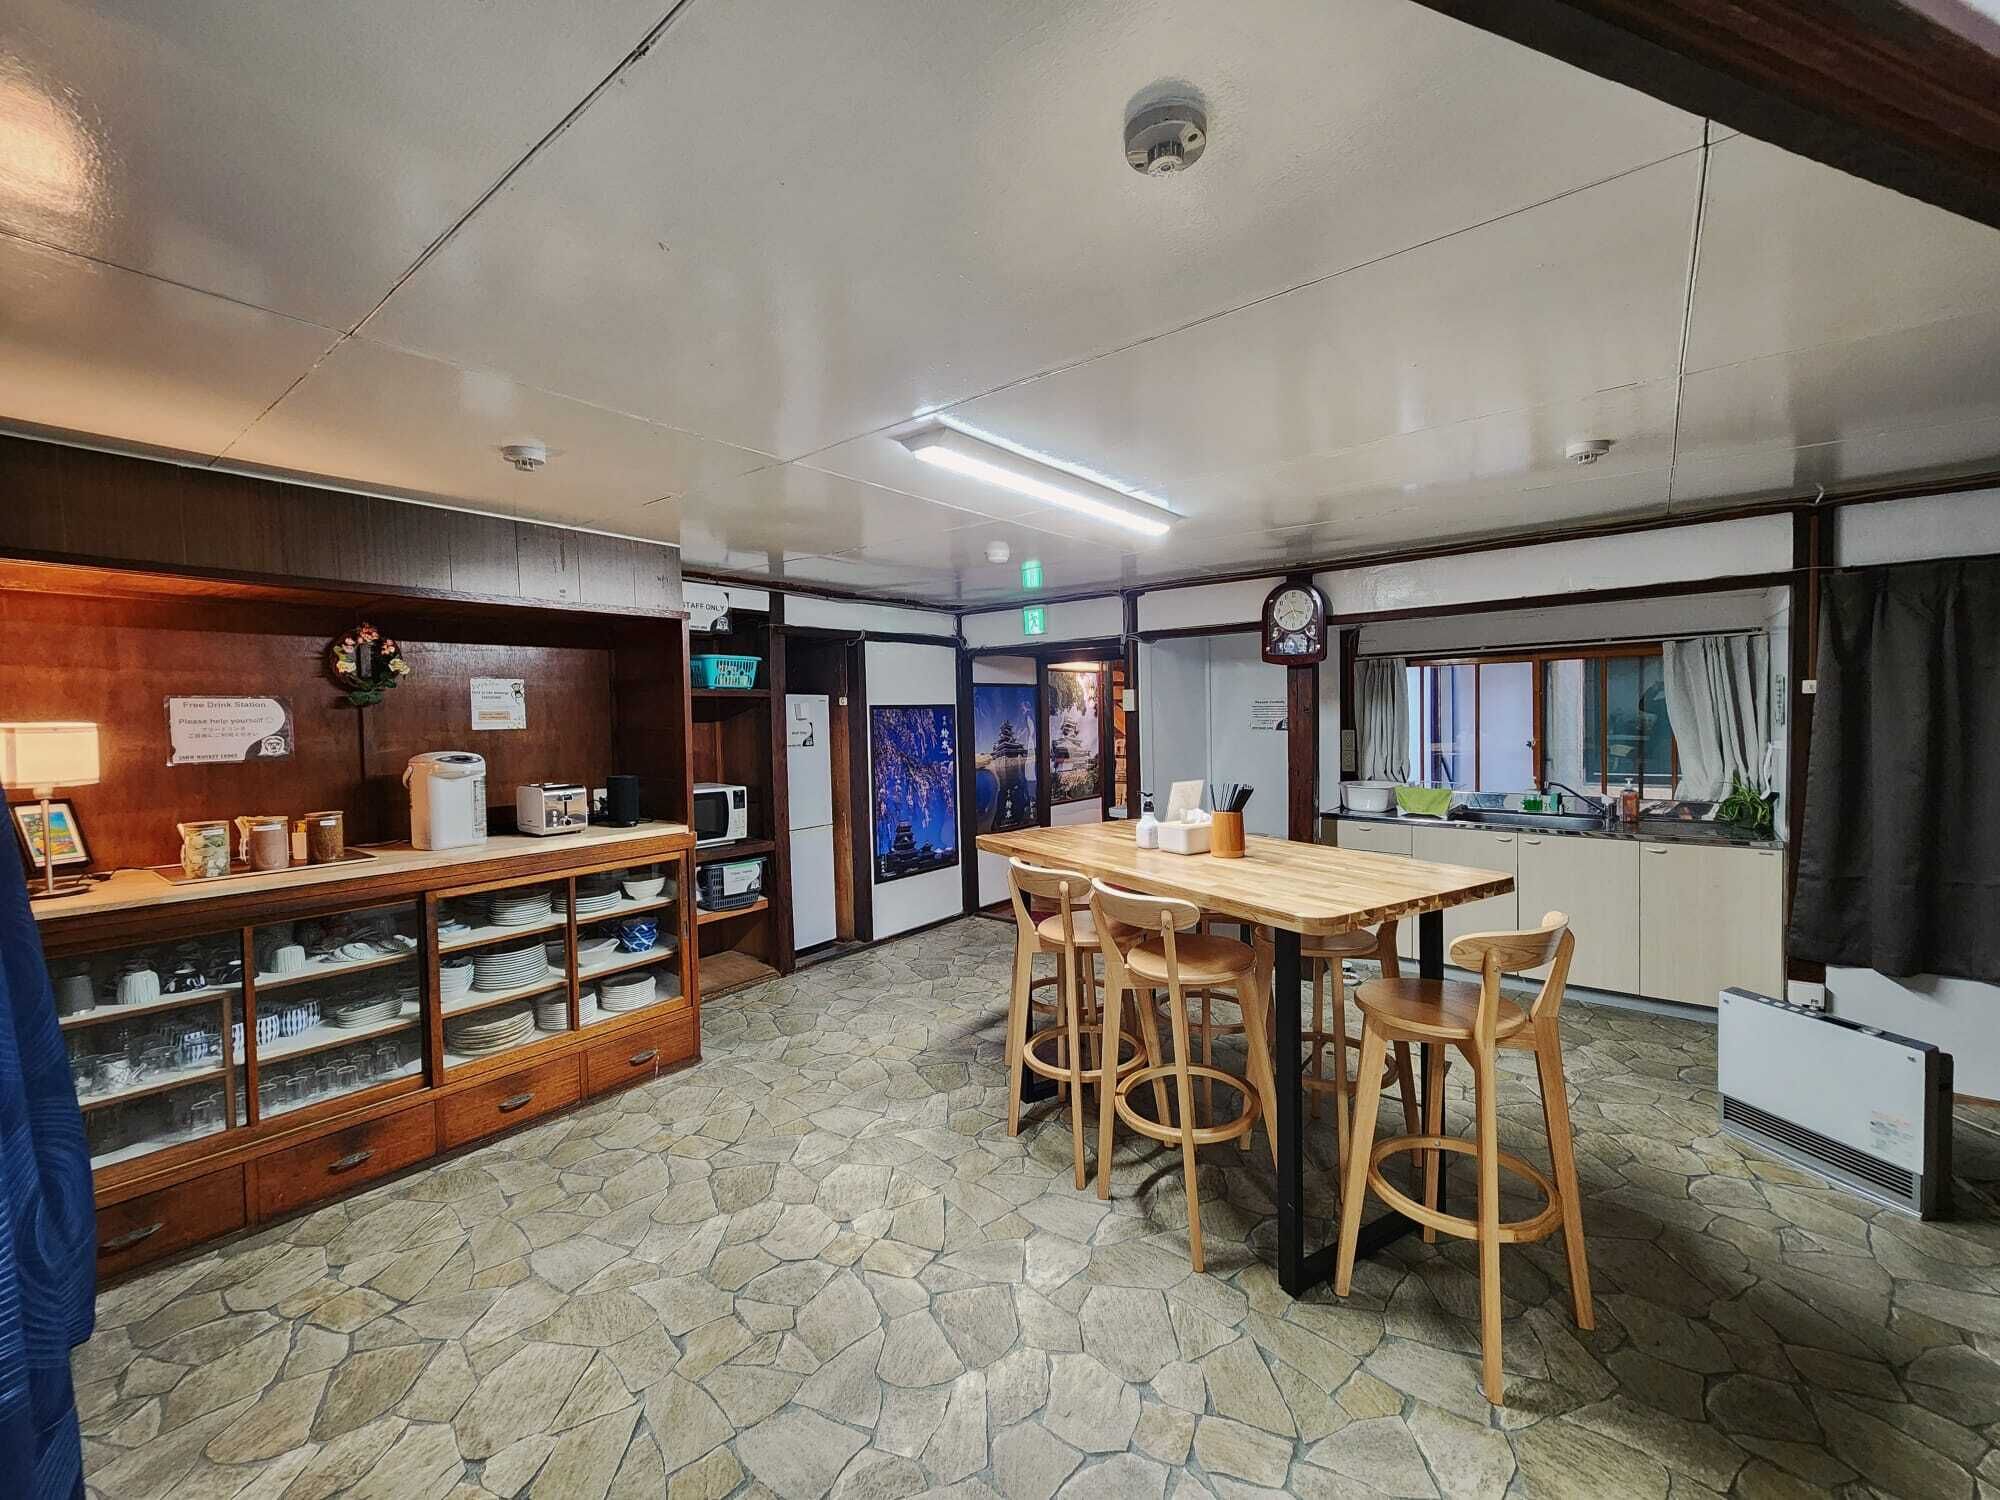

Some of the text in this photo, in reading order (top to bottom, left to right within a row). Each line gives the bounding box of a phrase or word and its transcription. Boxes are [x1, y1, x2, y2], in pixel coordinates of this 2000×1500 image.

[705, 603, 725, 611] ONLY
[183, 701, 266, 709] Free Drink Station
[210, 718, 226, 726] help
